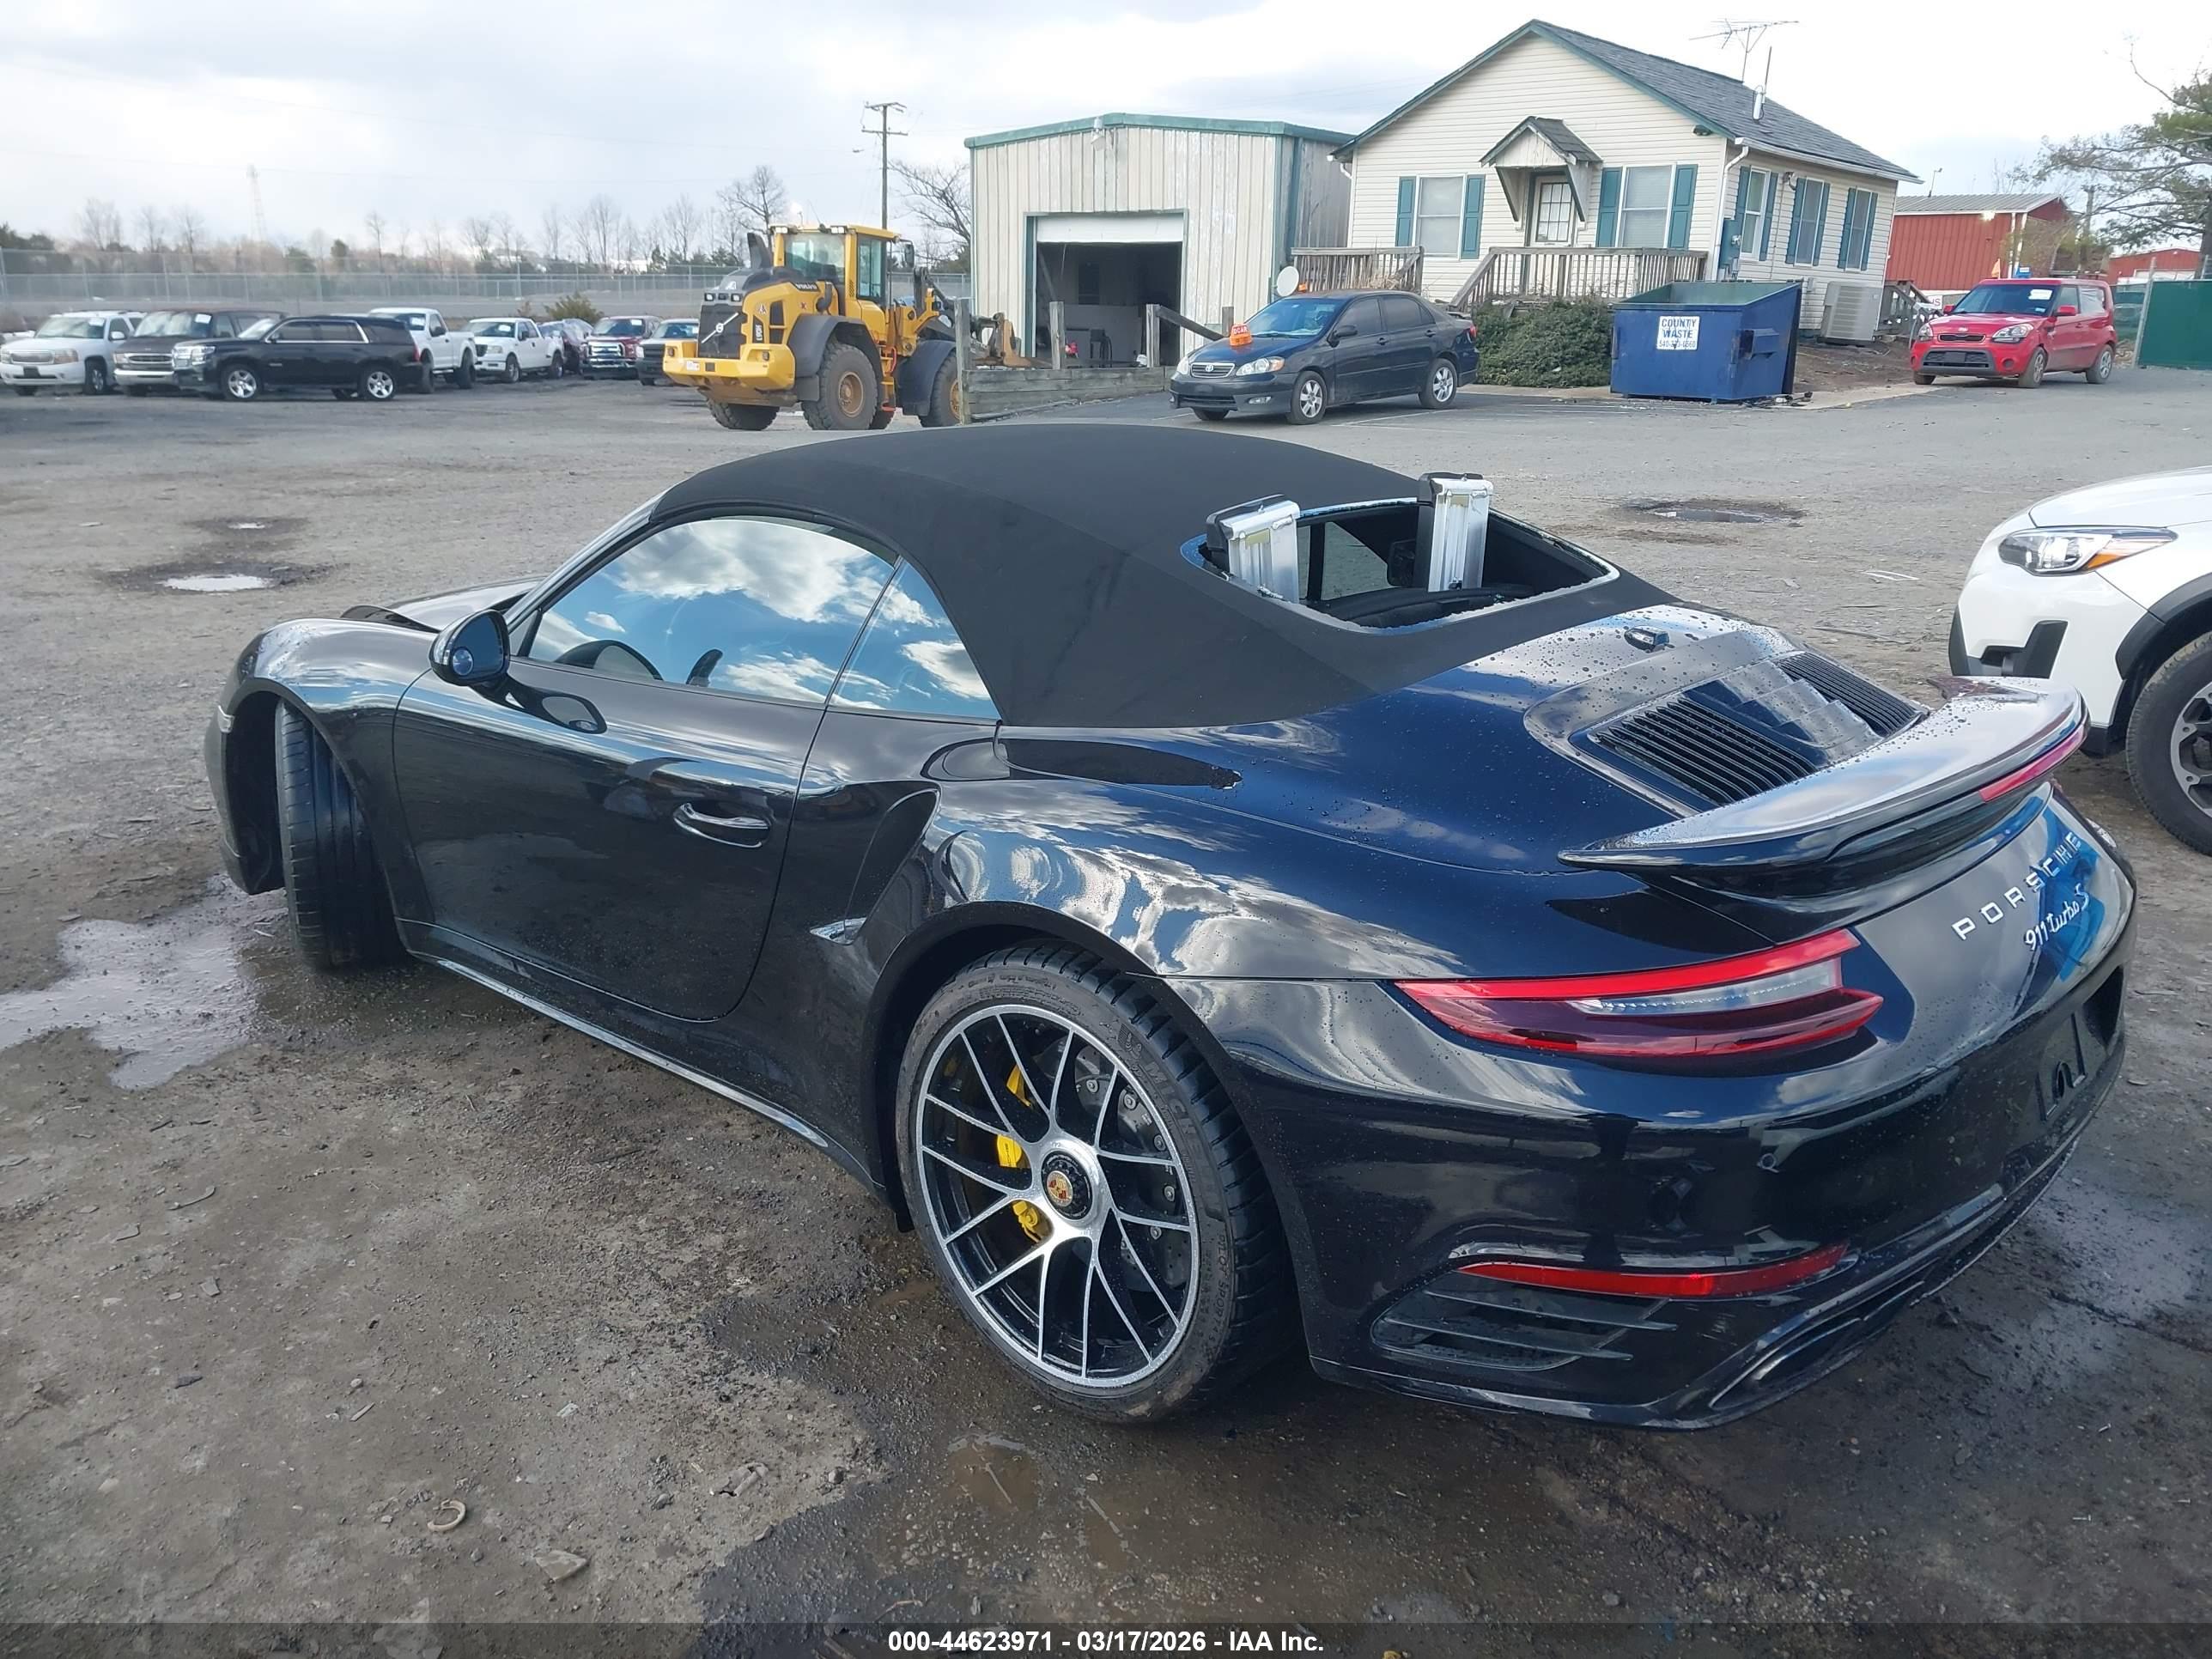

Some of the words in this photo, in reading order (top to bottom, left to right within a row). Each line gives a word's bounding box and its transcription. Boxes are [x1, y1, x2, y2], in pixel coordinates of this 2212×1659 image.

[1662, 319, 1697, 327] COUNTY
[1951, 831, 2082, 941] PORSCHE
[2024, 921, 2051, 951] 911
[2074, 882, 2090, 911] S
